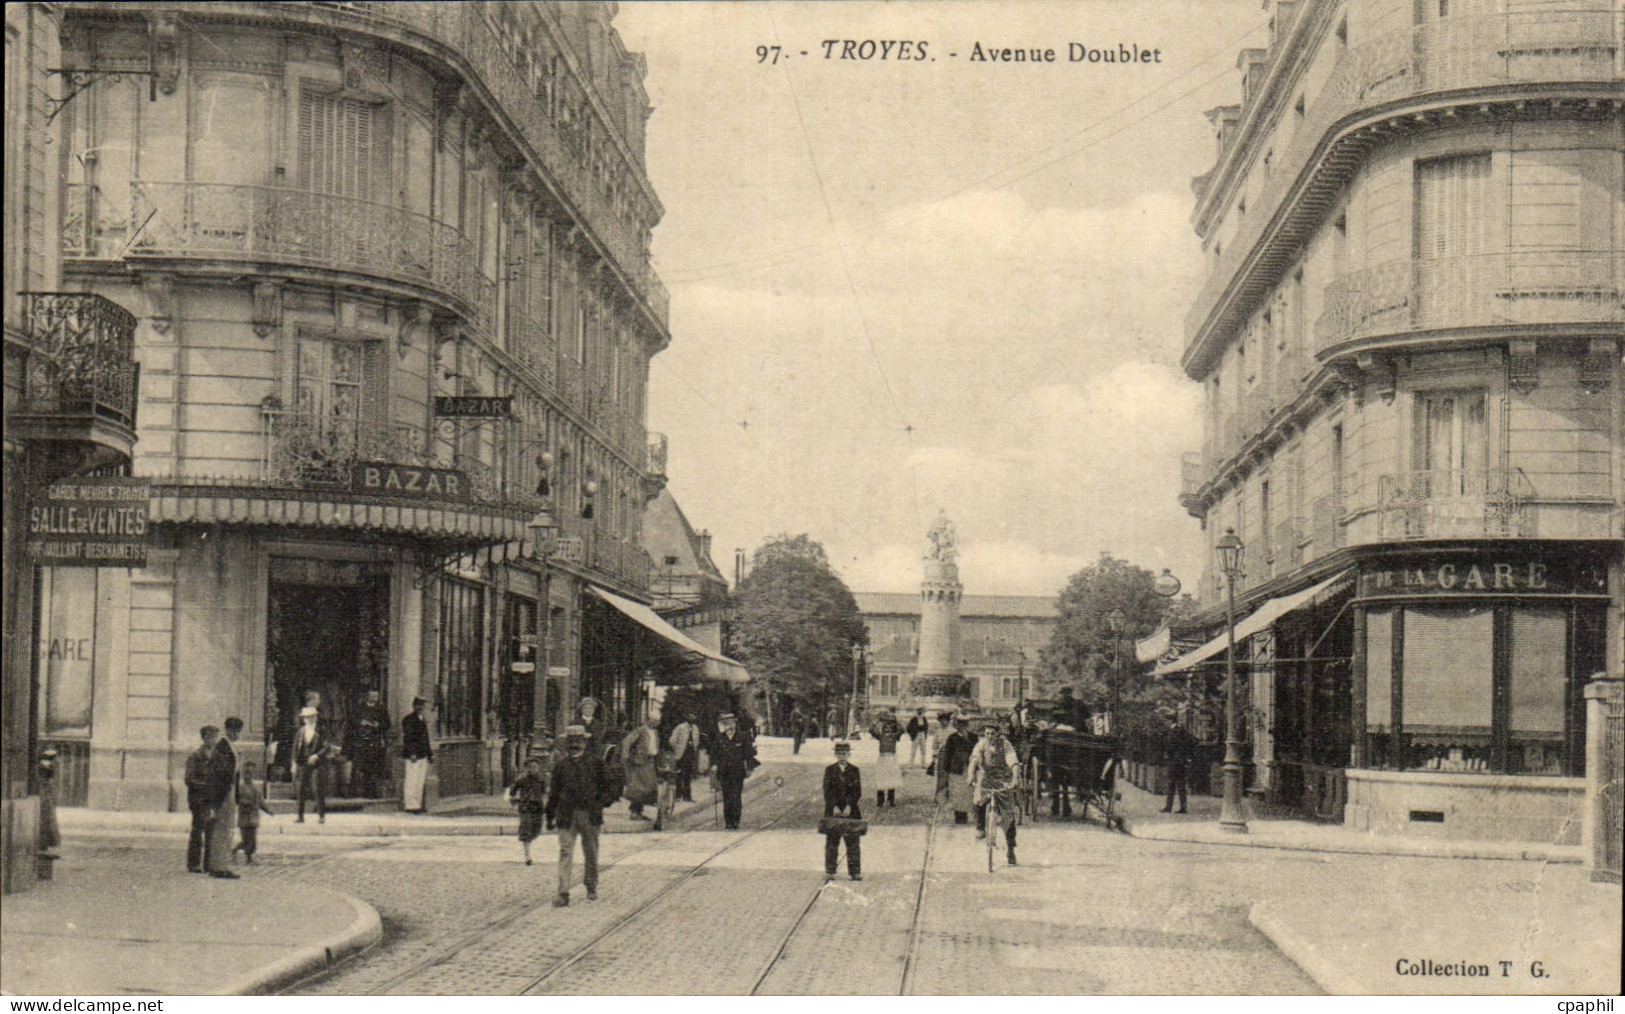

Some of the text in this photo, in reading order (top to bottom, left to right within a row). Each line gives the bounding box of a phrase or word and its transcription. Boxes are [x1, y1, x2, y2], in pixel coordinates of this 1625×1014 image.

[443, 399, 504, 415] BAZAR
[365, 467, 460, 495] BAZAR
[31, 506, 77, 533] SALLE
[88, 506, 145, 535] VENTES
[1404, 568, 1426, 586] LA
[1437, 562, 1548, 590] GARE
